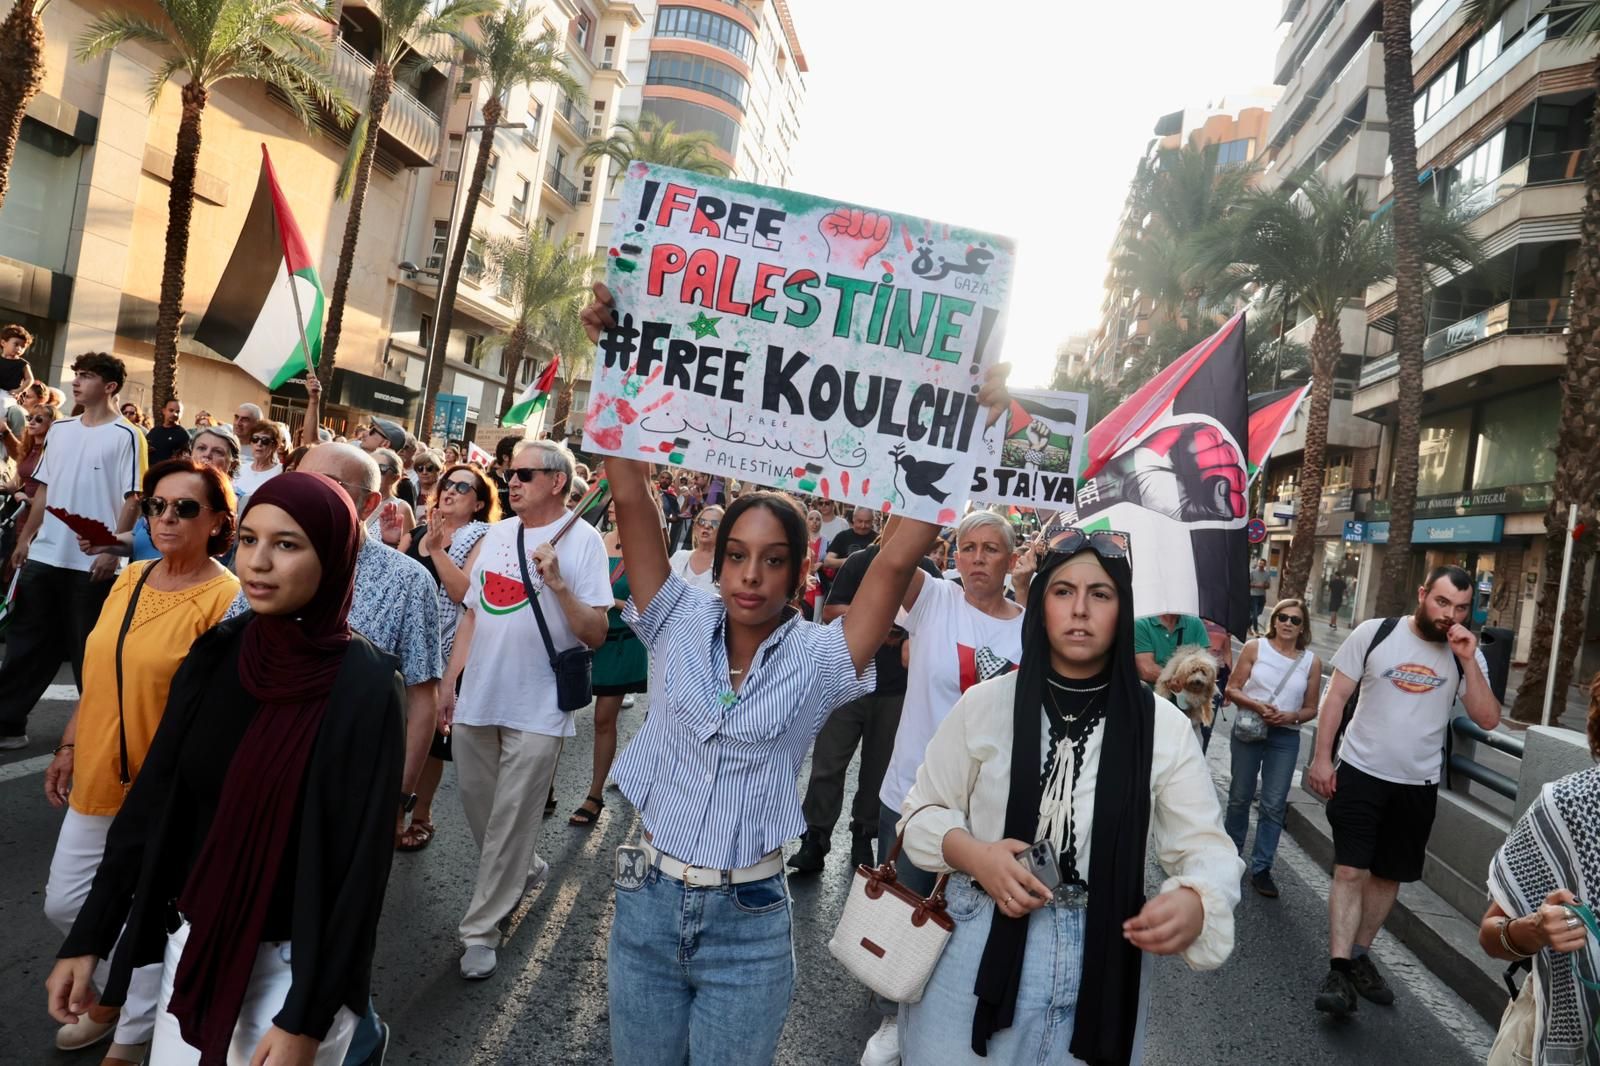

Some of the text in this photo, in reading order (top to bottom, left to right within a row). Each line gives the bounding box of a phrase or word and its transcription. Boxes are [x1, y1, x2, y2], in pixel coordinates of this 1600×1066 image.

[911, 238, 995, 280] غزة
[954, 277, 989, 295] GAZA
[599, 311, 750, 402] #FREE
[747, 414, 788, 428] FREE
[1472, 493, 1506, 505] INTEGRAL
